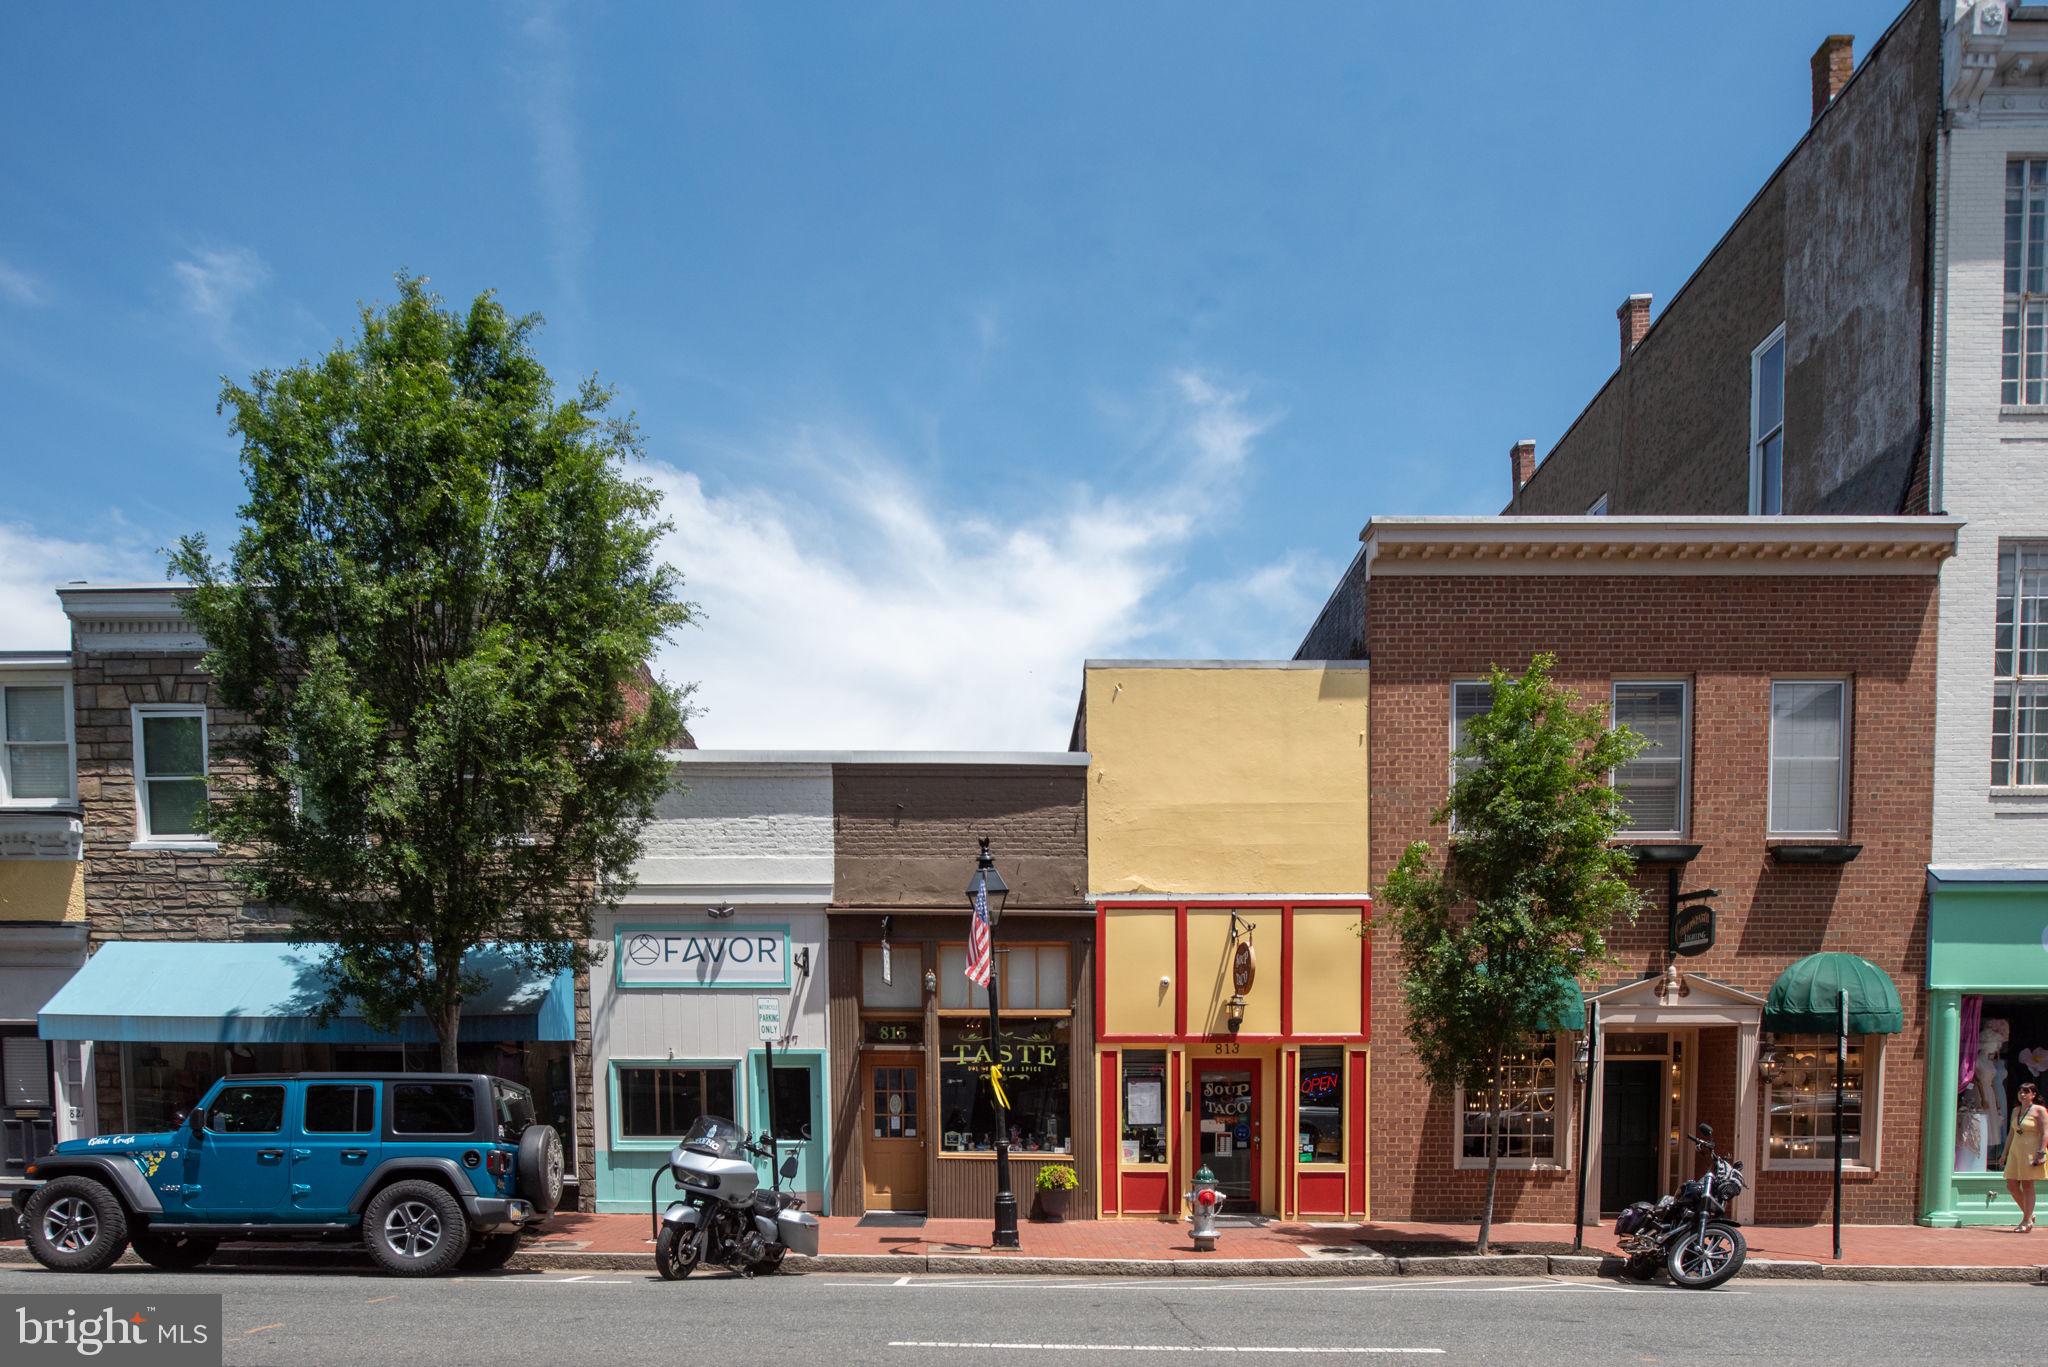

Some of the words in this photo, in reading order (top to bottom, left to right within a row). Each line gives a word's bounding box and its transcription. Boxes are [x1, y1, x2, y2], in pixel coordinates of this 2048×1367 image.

[664, 937, 777, 963] FAVOR
[759, 1014, 780, 1022] PARKING
[761, 1025, 778, 1034] ONLY
[880, 1026, 907, 1040] 815
[953, 1044, 1057, 1066] TASTE
[1215, 1043, 1240, 1055] 813
[1204, 1083, 1250, 1097] SOUP
[1300, 1073, 1338, 1094] OPEN
[1205, 1101, 1248, 1115] TACO
